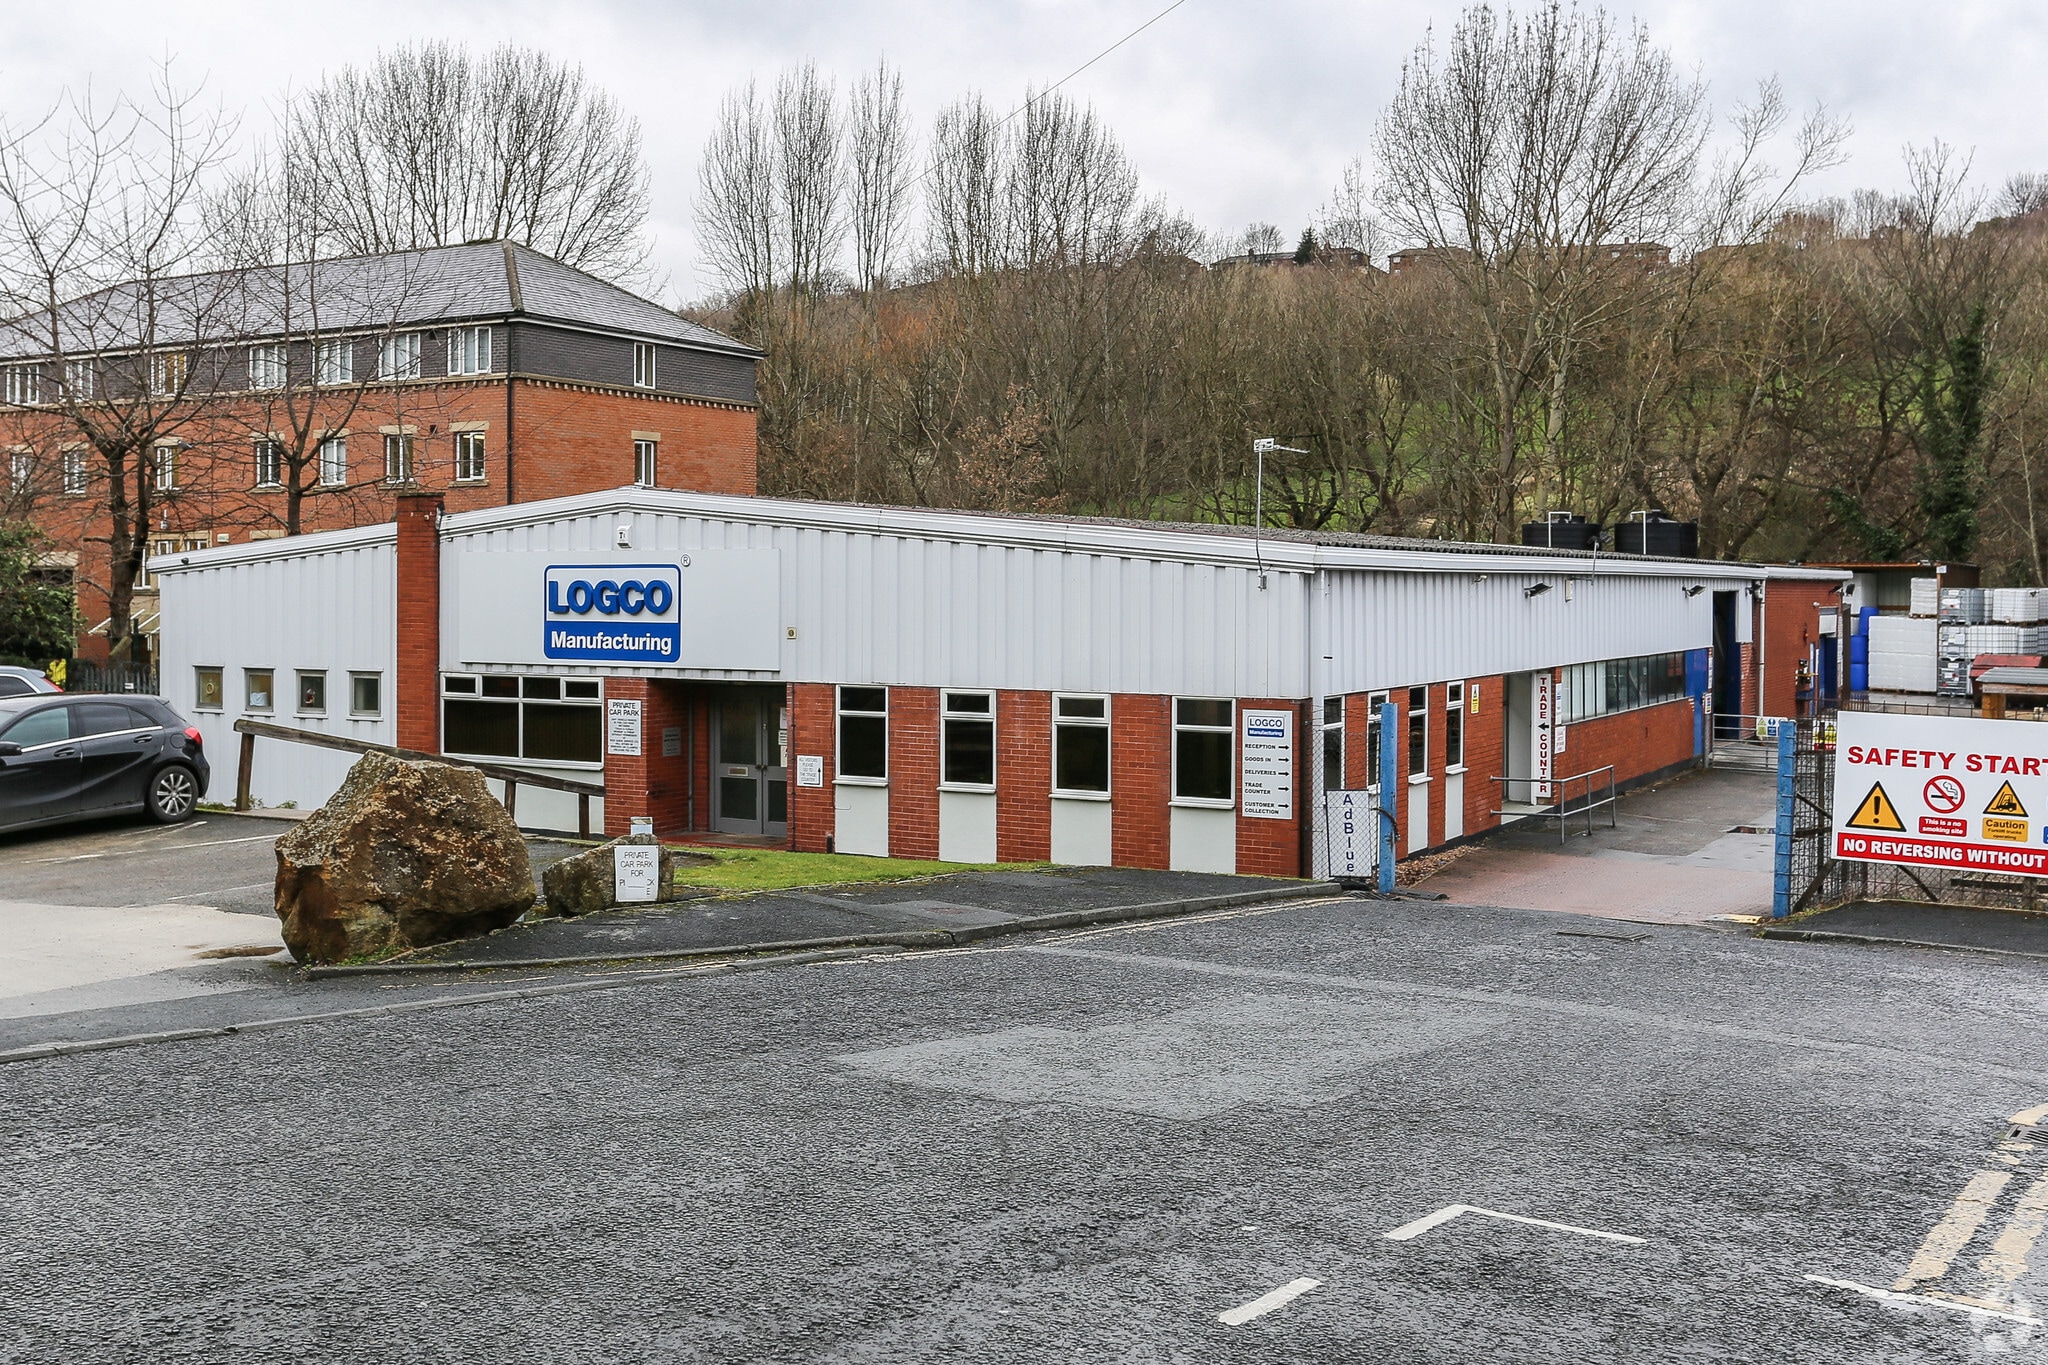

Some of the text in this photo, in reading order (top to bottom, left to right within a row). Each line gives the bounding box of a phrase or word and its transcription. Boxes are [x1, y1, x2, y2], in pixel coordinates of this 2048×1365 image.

[548, 580, 672, 615] LOGCO
[551, 631, 672, 656] Manufacturing
[1249, 718, 1283, 728] LOGCO
[1847, 746, 1956, 770] SAFETY
[1924, 818, 1939, 826] This
[1985, 819, 2025, 830] Caution
[1342, 794, 1354, 872] AdBlue
[1922, 826, 1950, 835] smoking
[624, 851, 649, 859] PRIVATE
[1843, 838, 2046, 869] NO REVERSING WITHOUT
[620, 860, 635, 868] CAR
[630, 869, 644, 877] FOR
